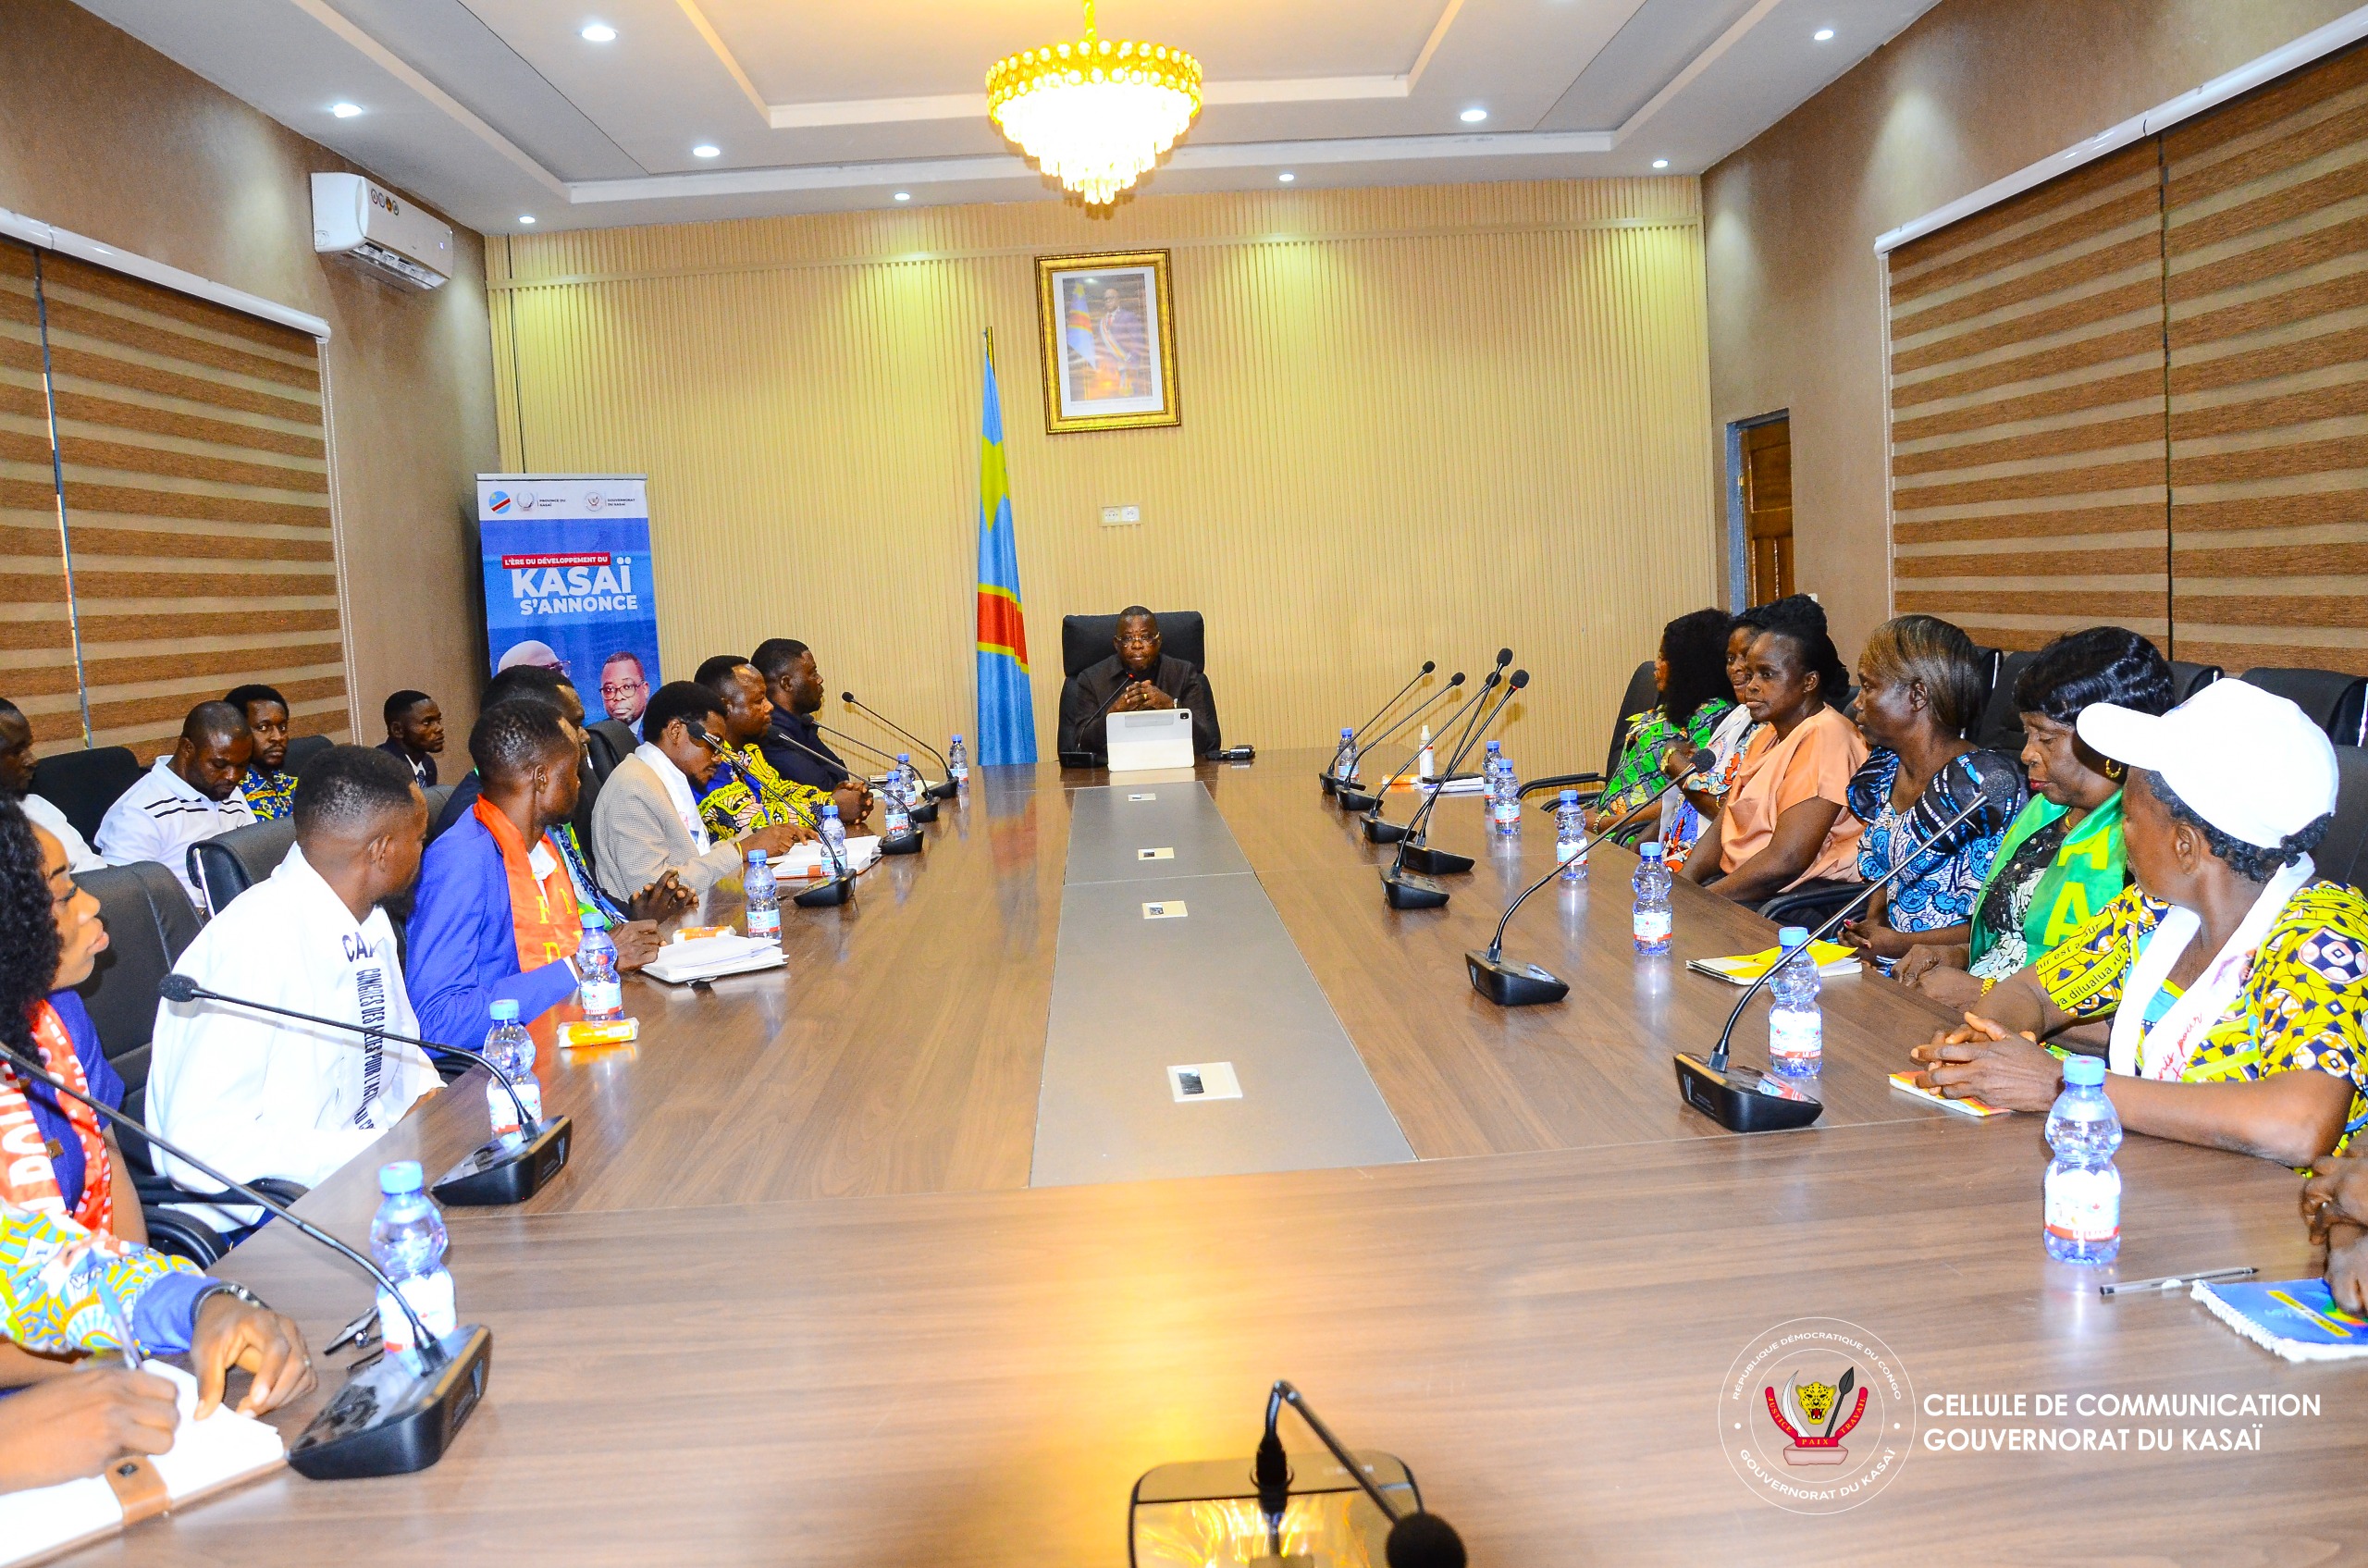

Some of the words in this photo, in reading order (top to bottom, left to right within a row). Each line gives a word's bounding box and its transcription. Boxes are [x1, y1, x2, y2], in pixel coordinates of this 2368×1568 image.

[537, 556, 597, 564] DÉVELOPPEMENT
[512, 557, 632, 599] KASAÏ
[520, 595, 638, 615] S'ANNONCE
[2054, 945, 2071, 960] est
[356, 968, 385, 1007] CONGRES
[362, 1006, 385, 1024] DES
[364, 1052, 382, 1078] POUR
